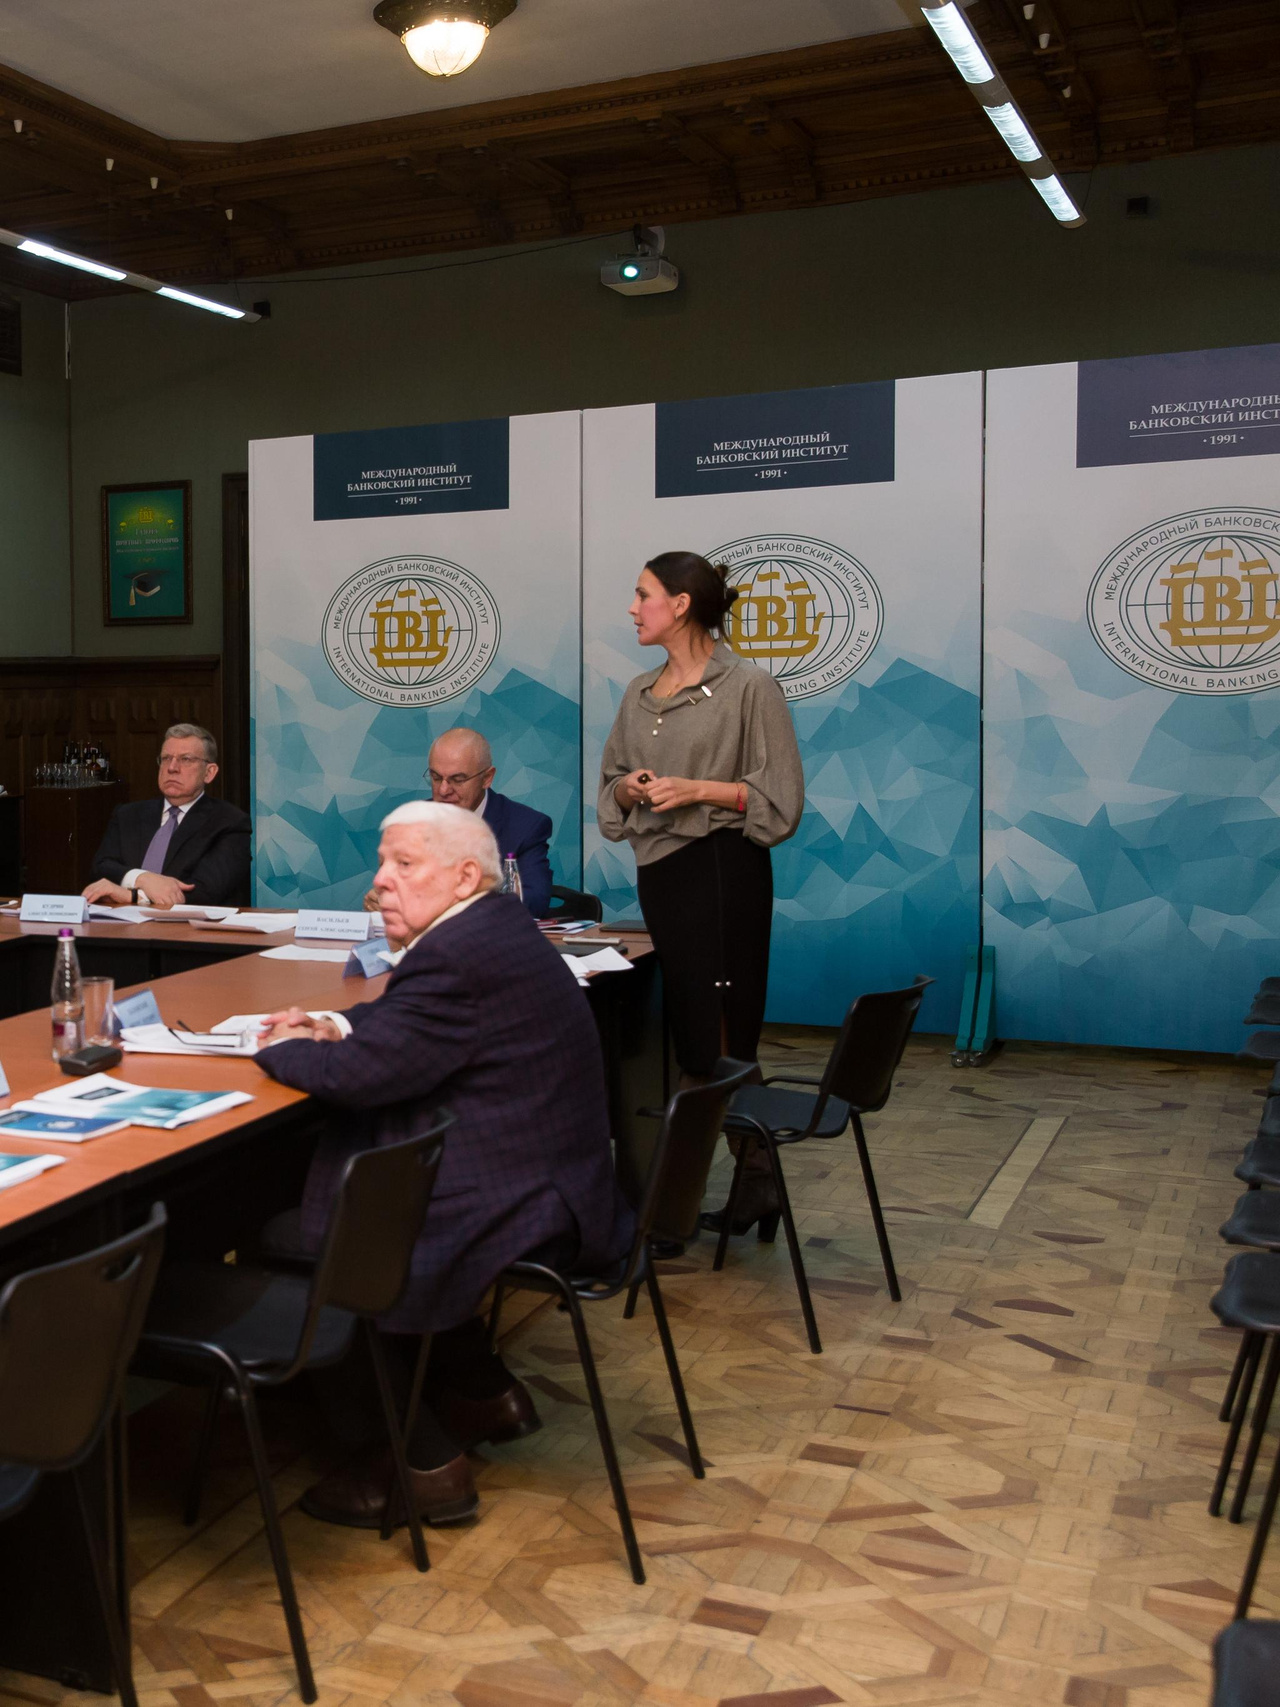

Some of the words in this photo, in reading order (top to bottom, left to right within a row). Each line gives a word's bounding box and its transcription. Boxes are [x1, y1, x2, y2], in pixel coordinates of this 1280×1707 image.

[1151, 394, 1280, 415] МЕЖДУНАРОДН
[1129, 411, 1234, 430] БАНКОВСКИЙ
[1238, 408, 1280, 422] ИНСТ
[713, 431, 830, 451] МЕЖДУНАРОДНЫЙ
[1210, 434, 1237, 445] 1991
[696, 448, 779, 465] БАНКОВСКИЙ
[782, 444, 849, 458] ИНСТИТУТ
[361, 463, 457, 480] МЕЖДУНАРОДНЫЙ
[760, 469, 781, 479] 1991
[347, 477, 416, 492] БАНКОВСКИЙ
[417, 475, 472, 487] ИНСТИТУТ
[400, 496, 418, 505] 1991
[1104, 519, 1199, 601] МЕЖДУНАРОДНЫЙ
[1204, 516, 1280, 532] БАНКОВСК
[756, 542, 834, 563] БАНКОВСКИЙ
[833, 559, 869, 610] ИНСТИТУТ
[333, 564, 395, 629] МЕЖДУНАРОДНЫЙ
[397, 562, 460, 582] БАНКОВСКИЙ
[459, 579, 489, 625] ИНСТИТУТ
[785, 679, 817, 695] KING
[821, 629, 869, 683] INSTITUTE
[1103, 621, 1198, 687] INTERNATIONAL
[1206, 669, 1279, 689] BANKING
[333, 646, 395, 701] INTERNATIONAL
[400, 688, 447, 702] BANKING
[450, 642, 489, 690] INSTITUTE
